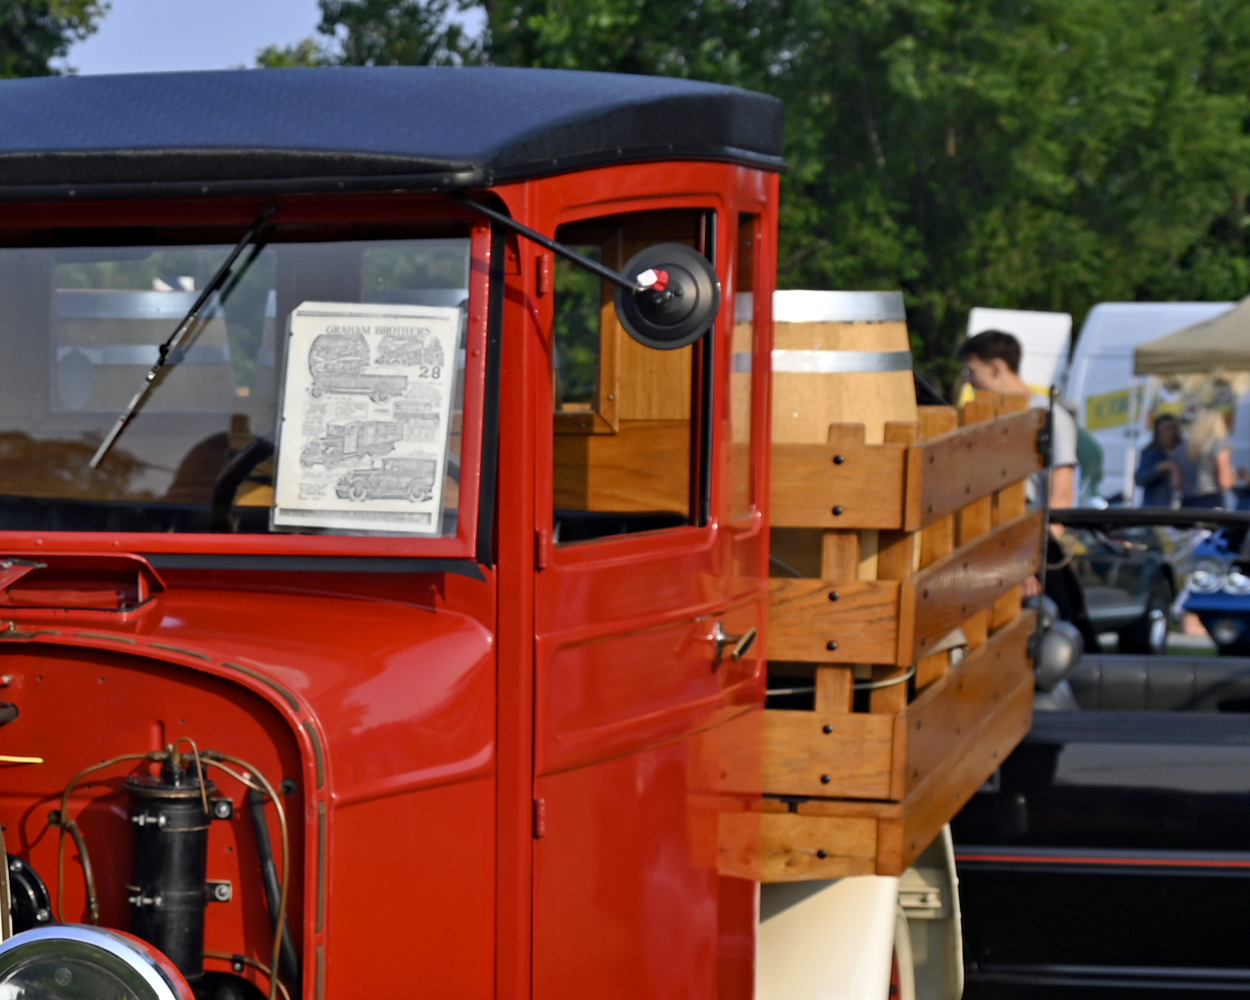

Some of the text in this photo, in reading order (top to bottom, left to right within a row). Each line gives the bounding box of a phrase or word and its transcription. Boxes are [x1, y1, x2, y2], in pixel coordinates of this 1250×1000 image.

[326, 325, 432, 336] GRAHAM BROTHERS
[418, 365, 442, 379] 28
